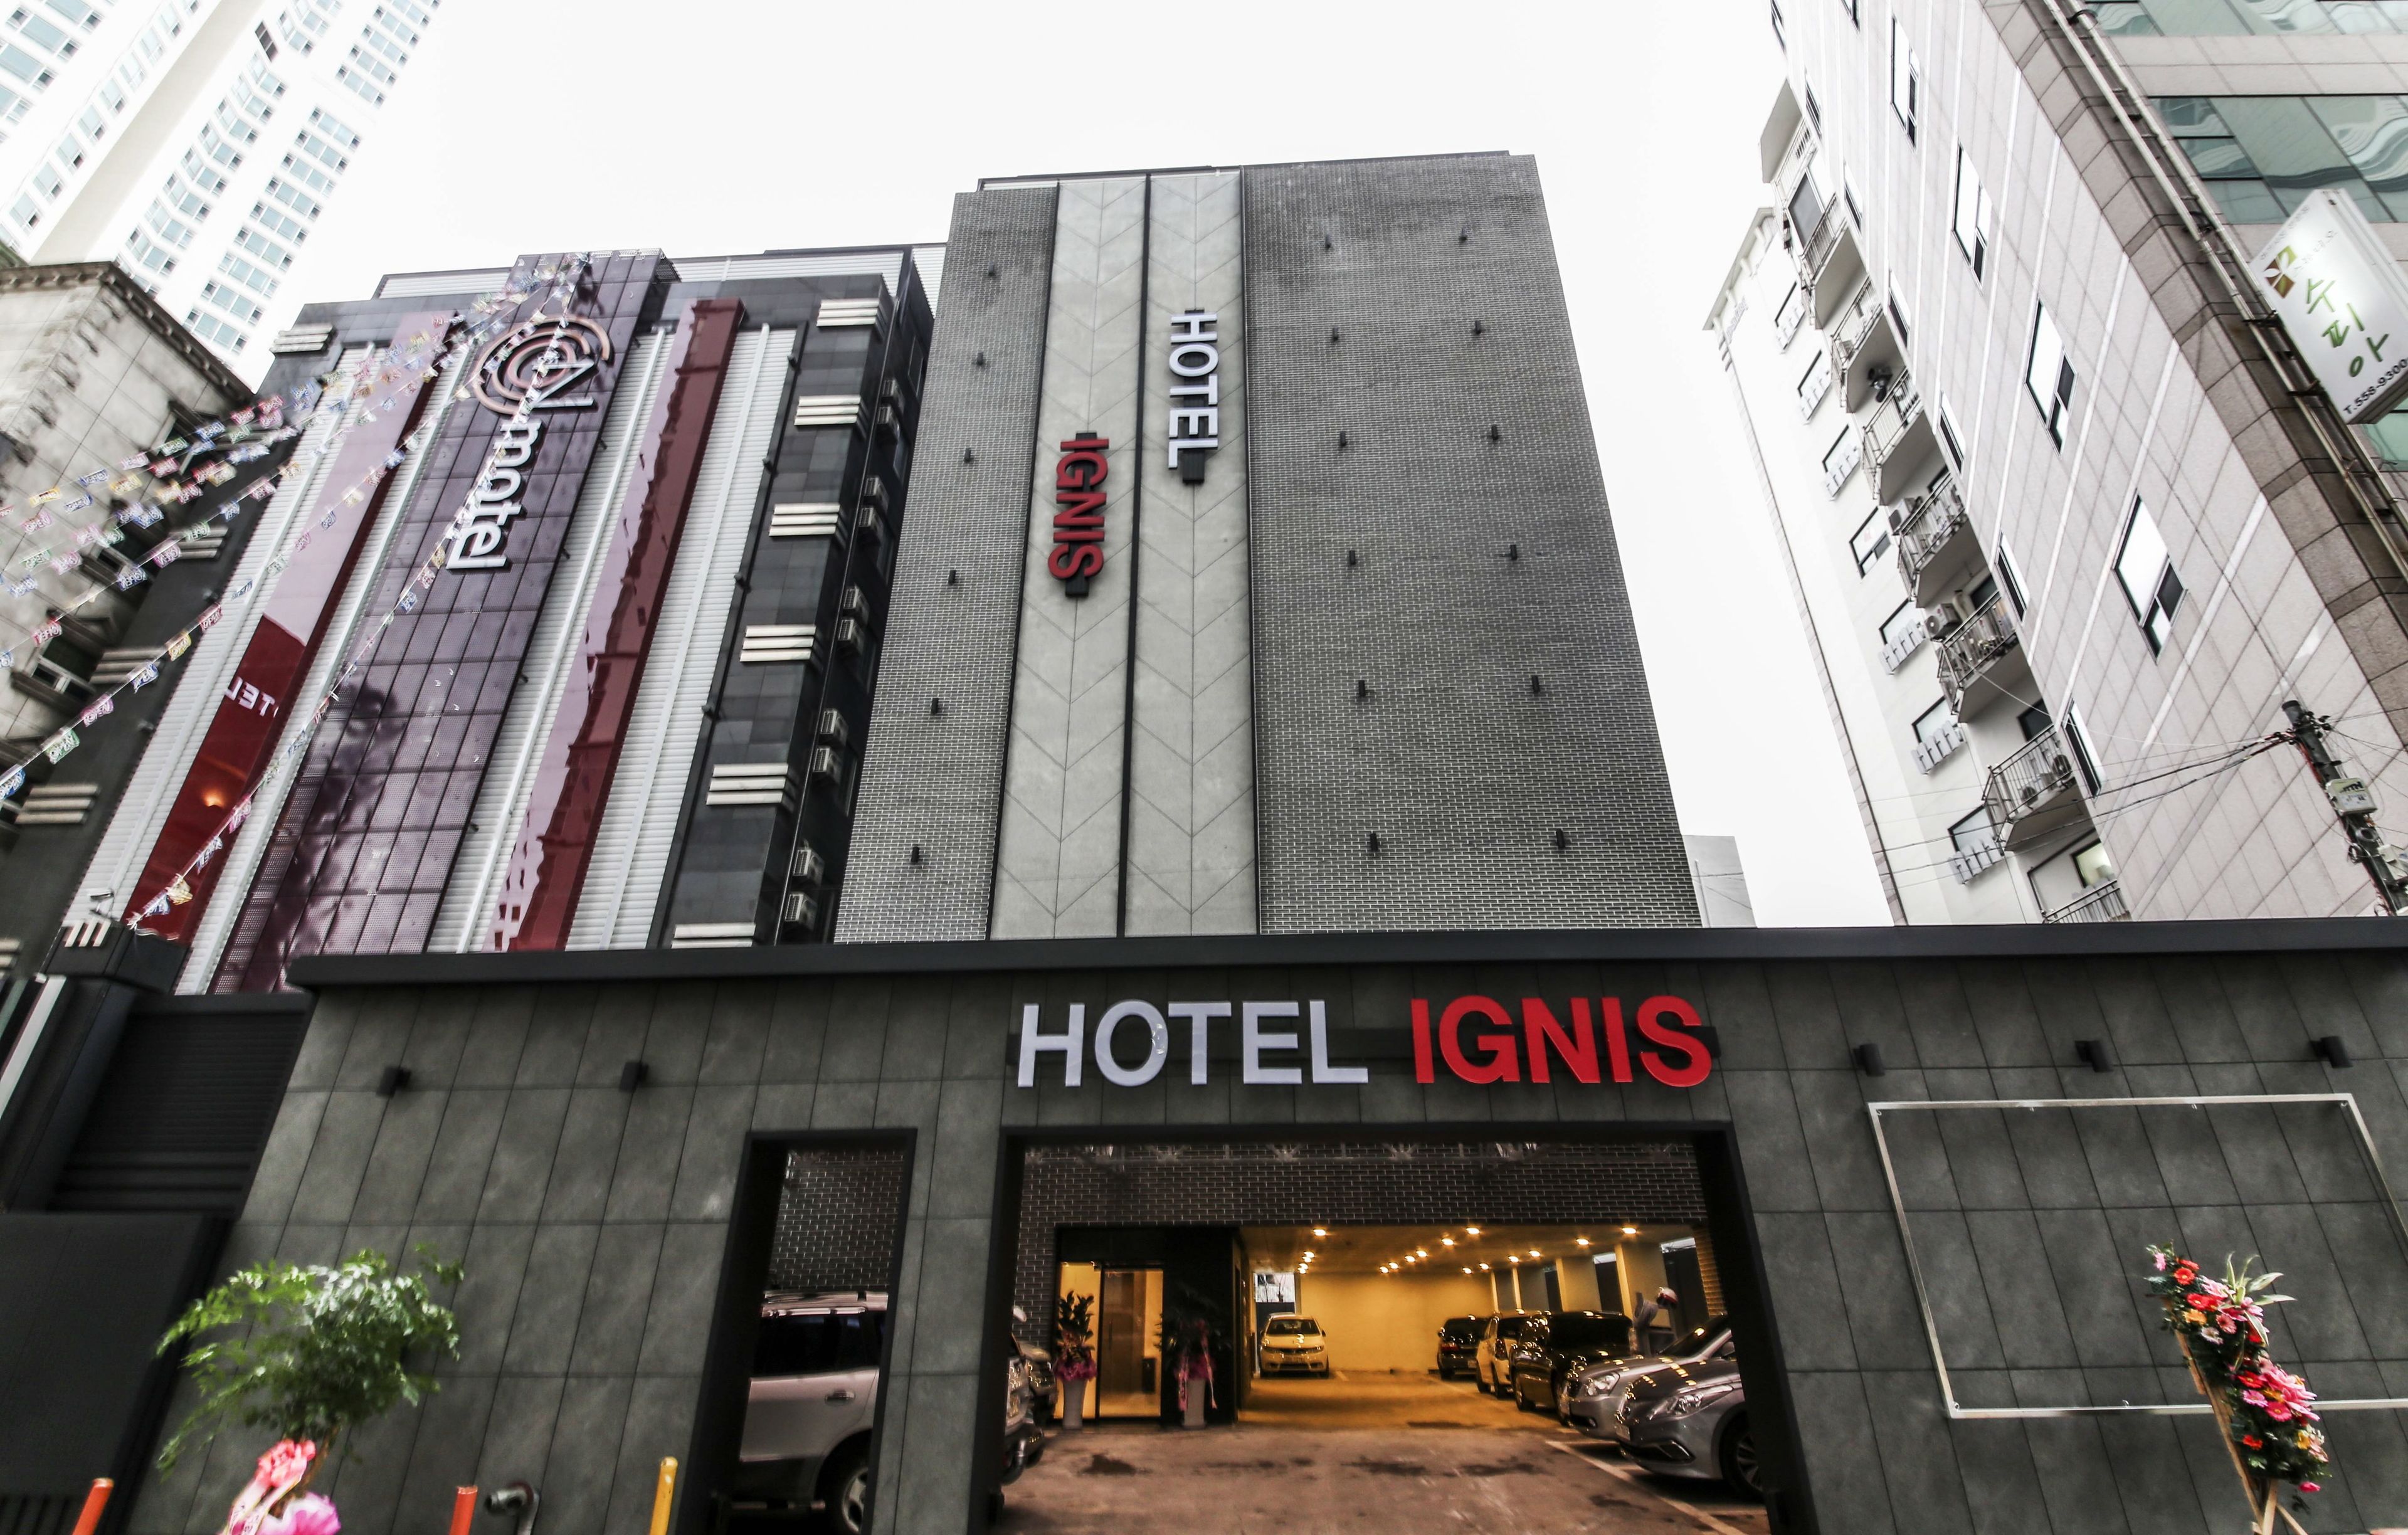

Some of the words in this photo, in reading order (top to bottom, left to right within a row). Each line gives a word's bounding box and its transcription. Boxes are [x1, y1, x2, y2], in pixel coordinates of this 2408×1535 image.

[1168, 313, 1218, 469] HOTEL
[2306, 278, 2390, 377] 수피아
[445, 420, 542, 570] motel
[1047, 437, 1109, 580] IGNIS
[1017, 999, 1369, 1088] HOTEL
[1411, 994, 1713, 1087] IGNIS
